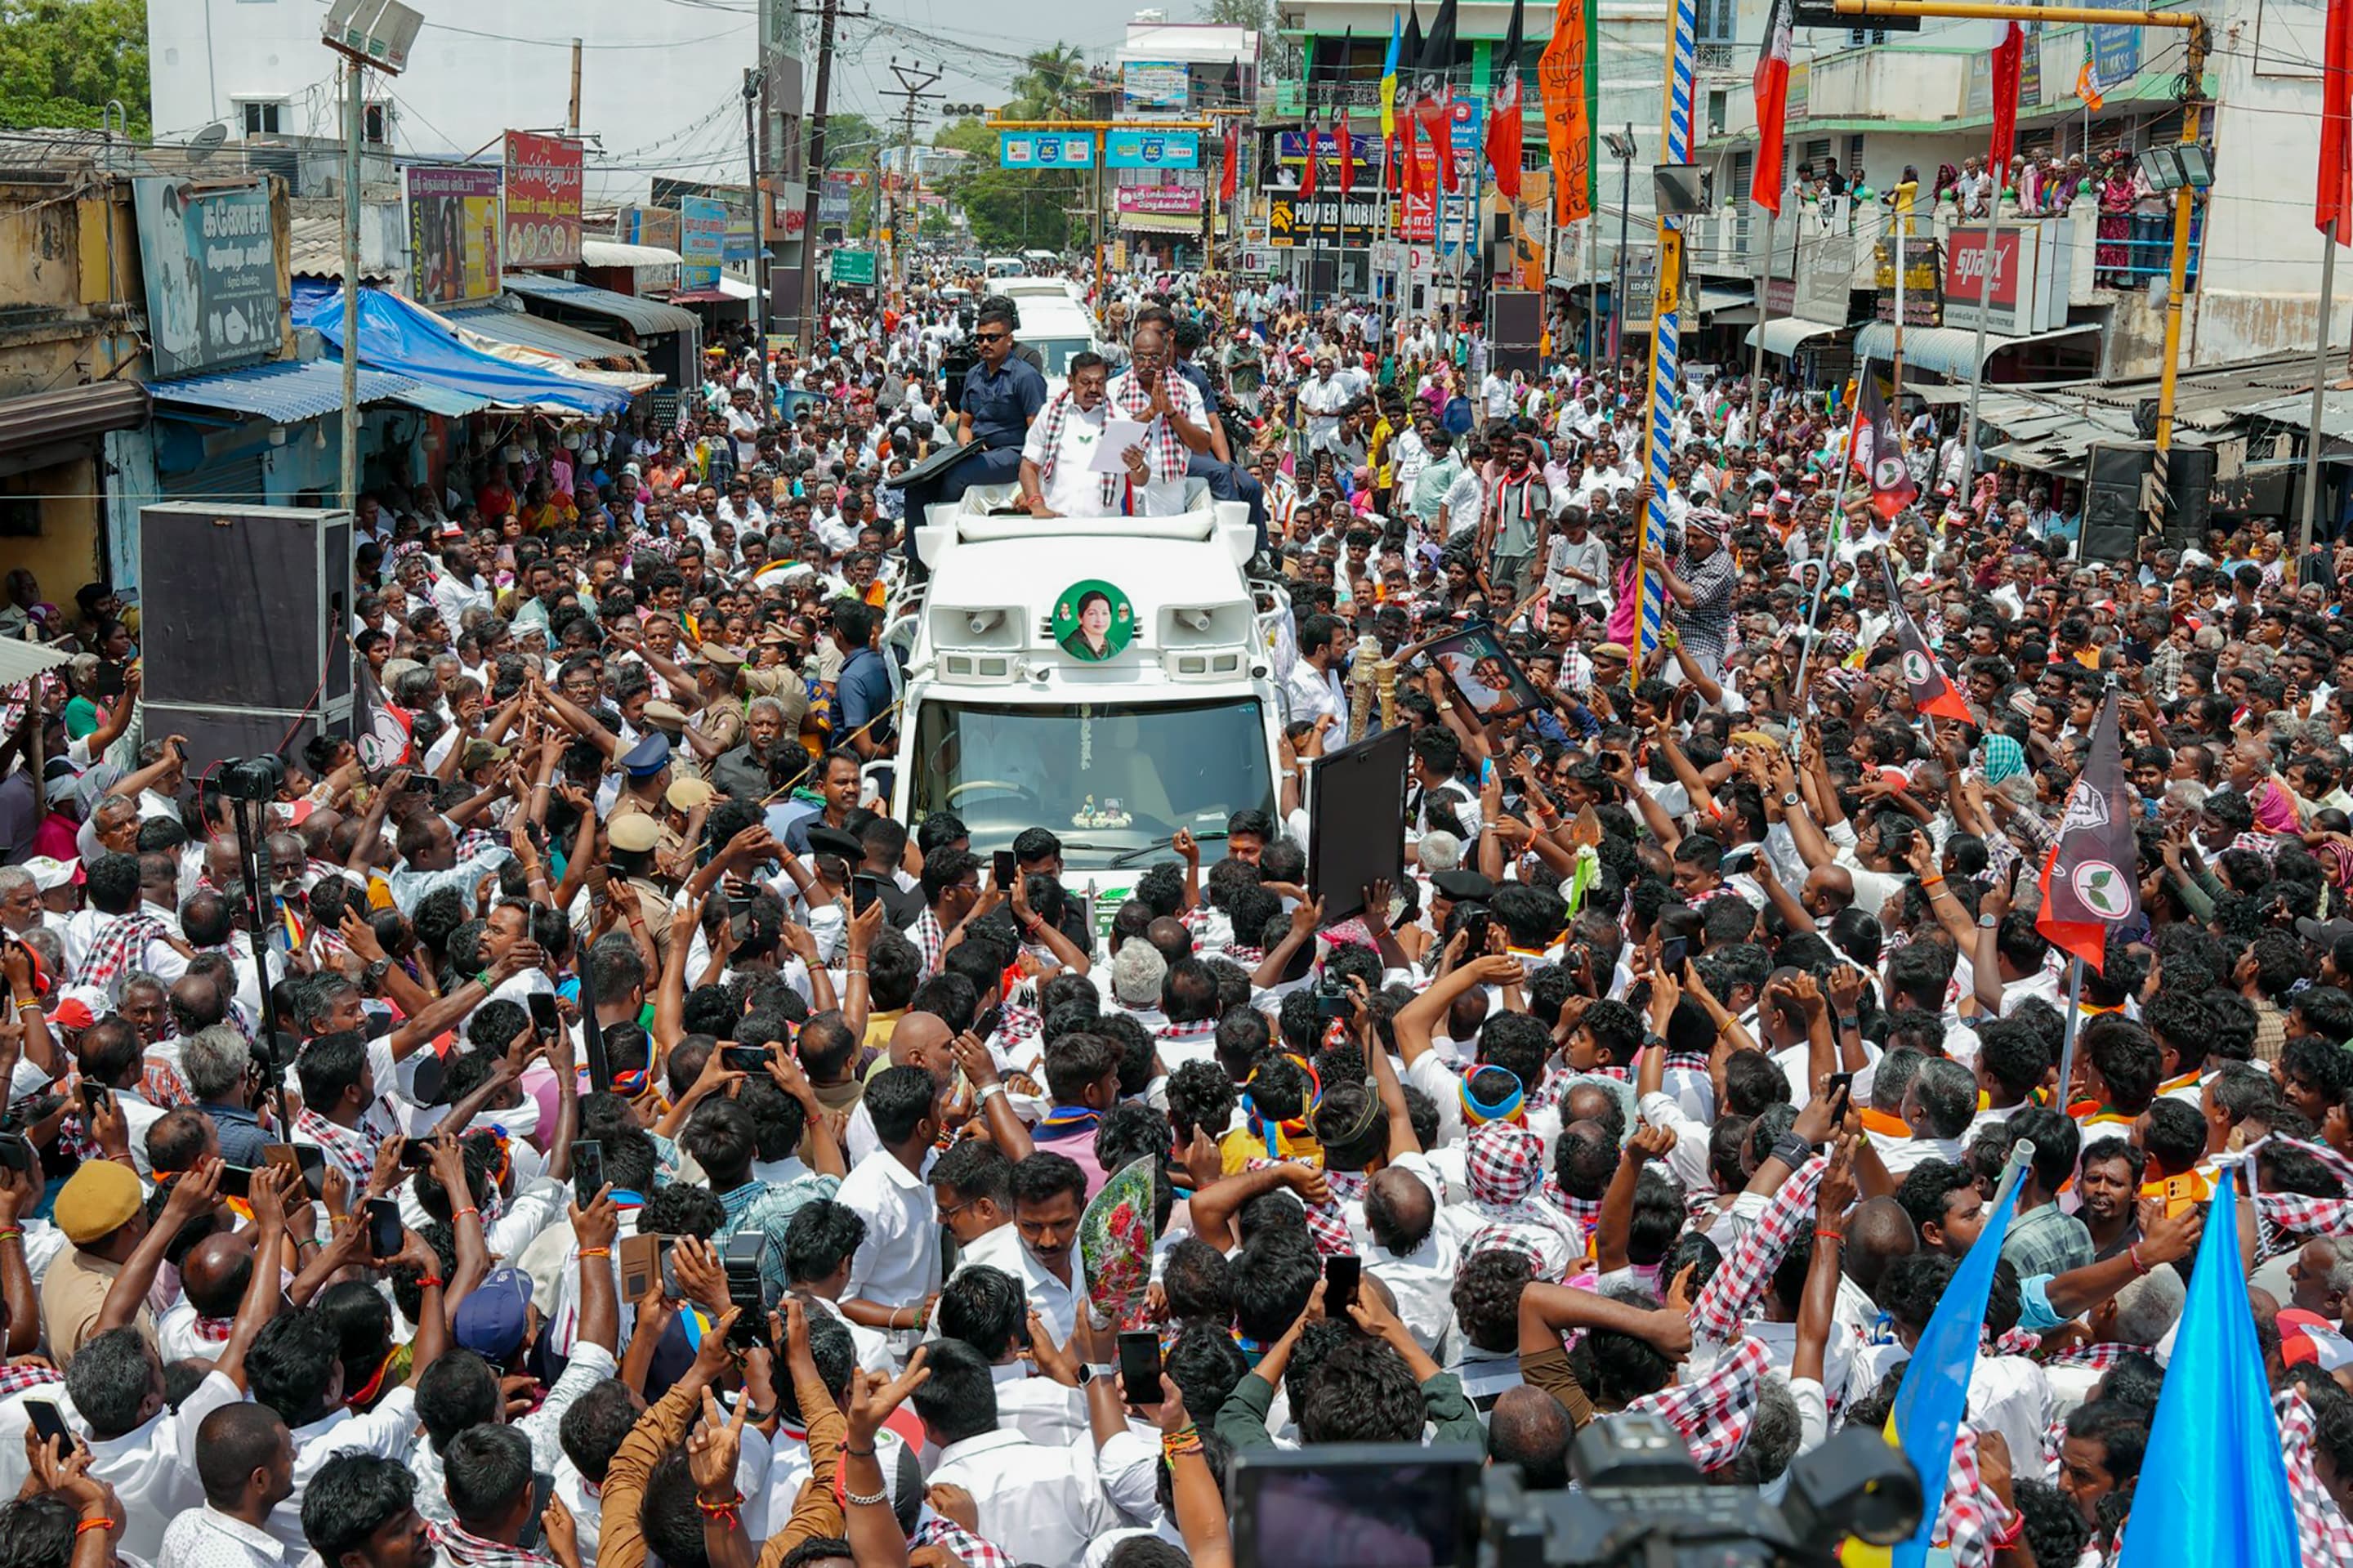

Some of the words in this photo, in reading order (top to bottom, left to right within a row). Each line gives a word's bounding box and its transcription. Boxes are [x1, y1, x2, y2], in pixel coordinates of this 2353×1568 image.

[203, 198, 268, 239] கணேசா
[1295, 203, 1338, 225] POWER
[1954, 244, 2011, 285] spax
